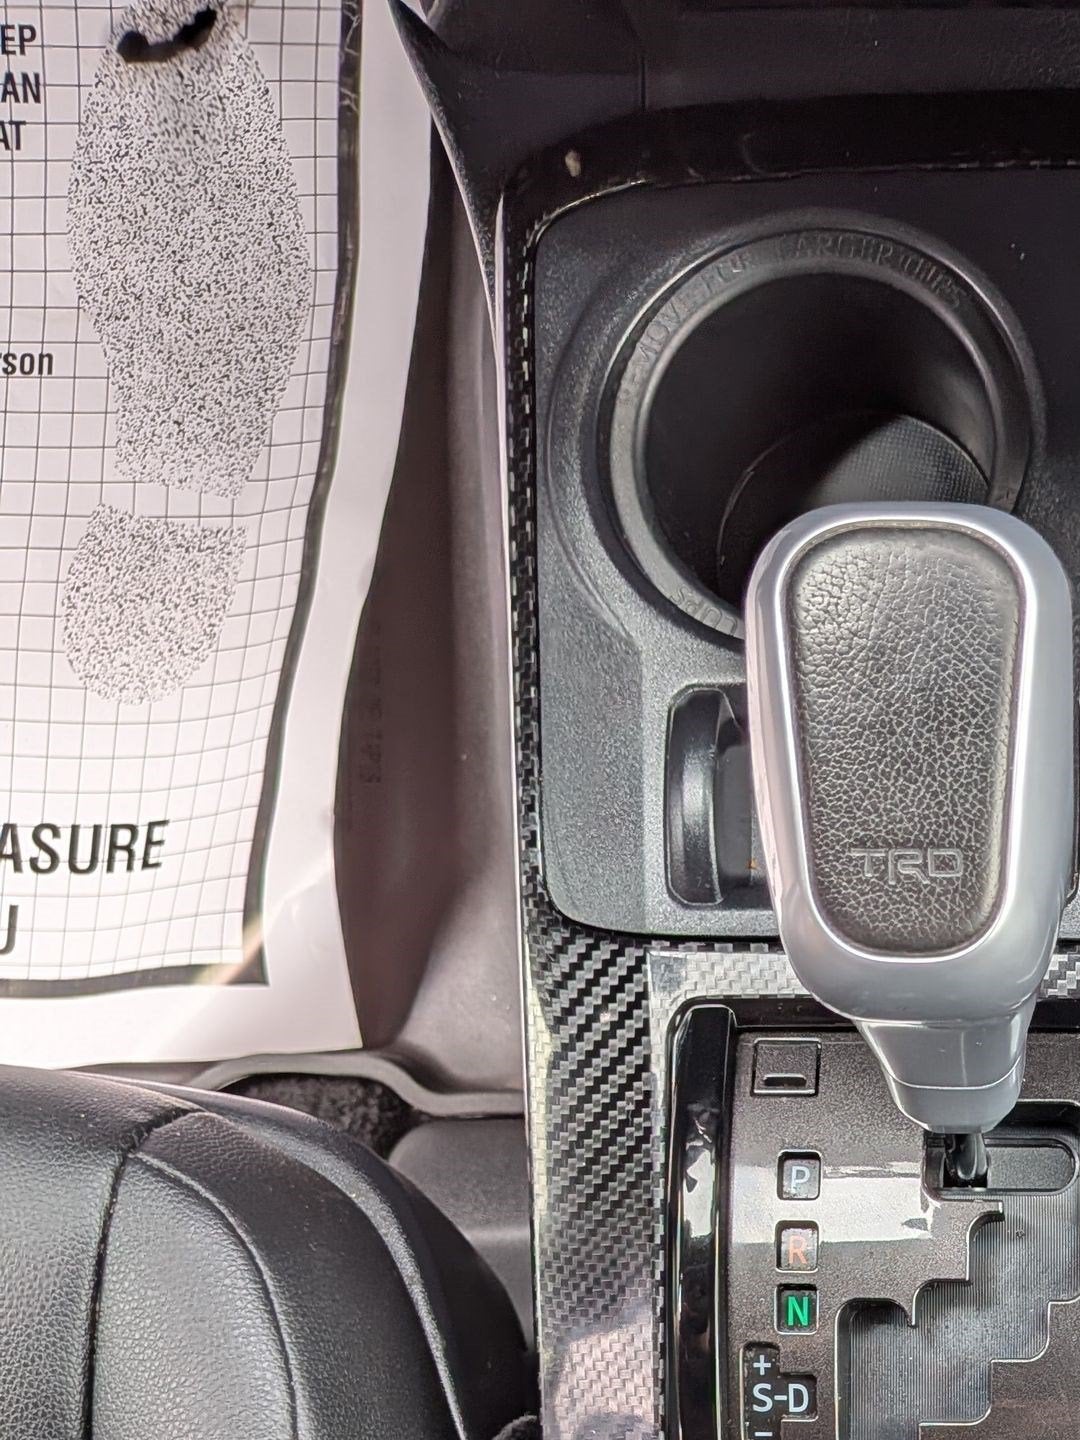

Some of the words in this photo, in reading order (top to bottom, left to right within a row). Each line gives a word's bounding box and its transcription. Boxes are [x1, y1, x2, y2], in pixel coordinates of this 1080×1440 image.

[1, 72, 42, 104] AN
[851, 848, 964, 885] TRD
[790, 1165, 811, 1193] P
[788, 1235, 808, 1265] R
[787, 1296, 811, 1326] N
